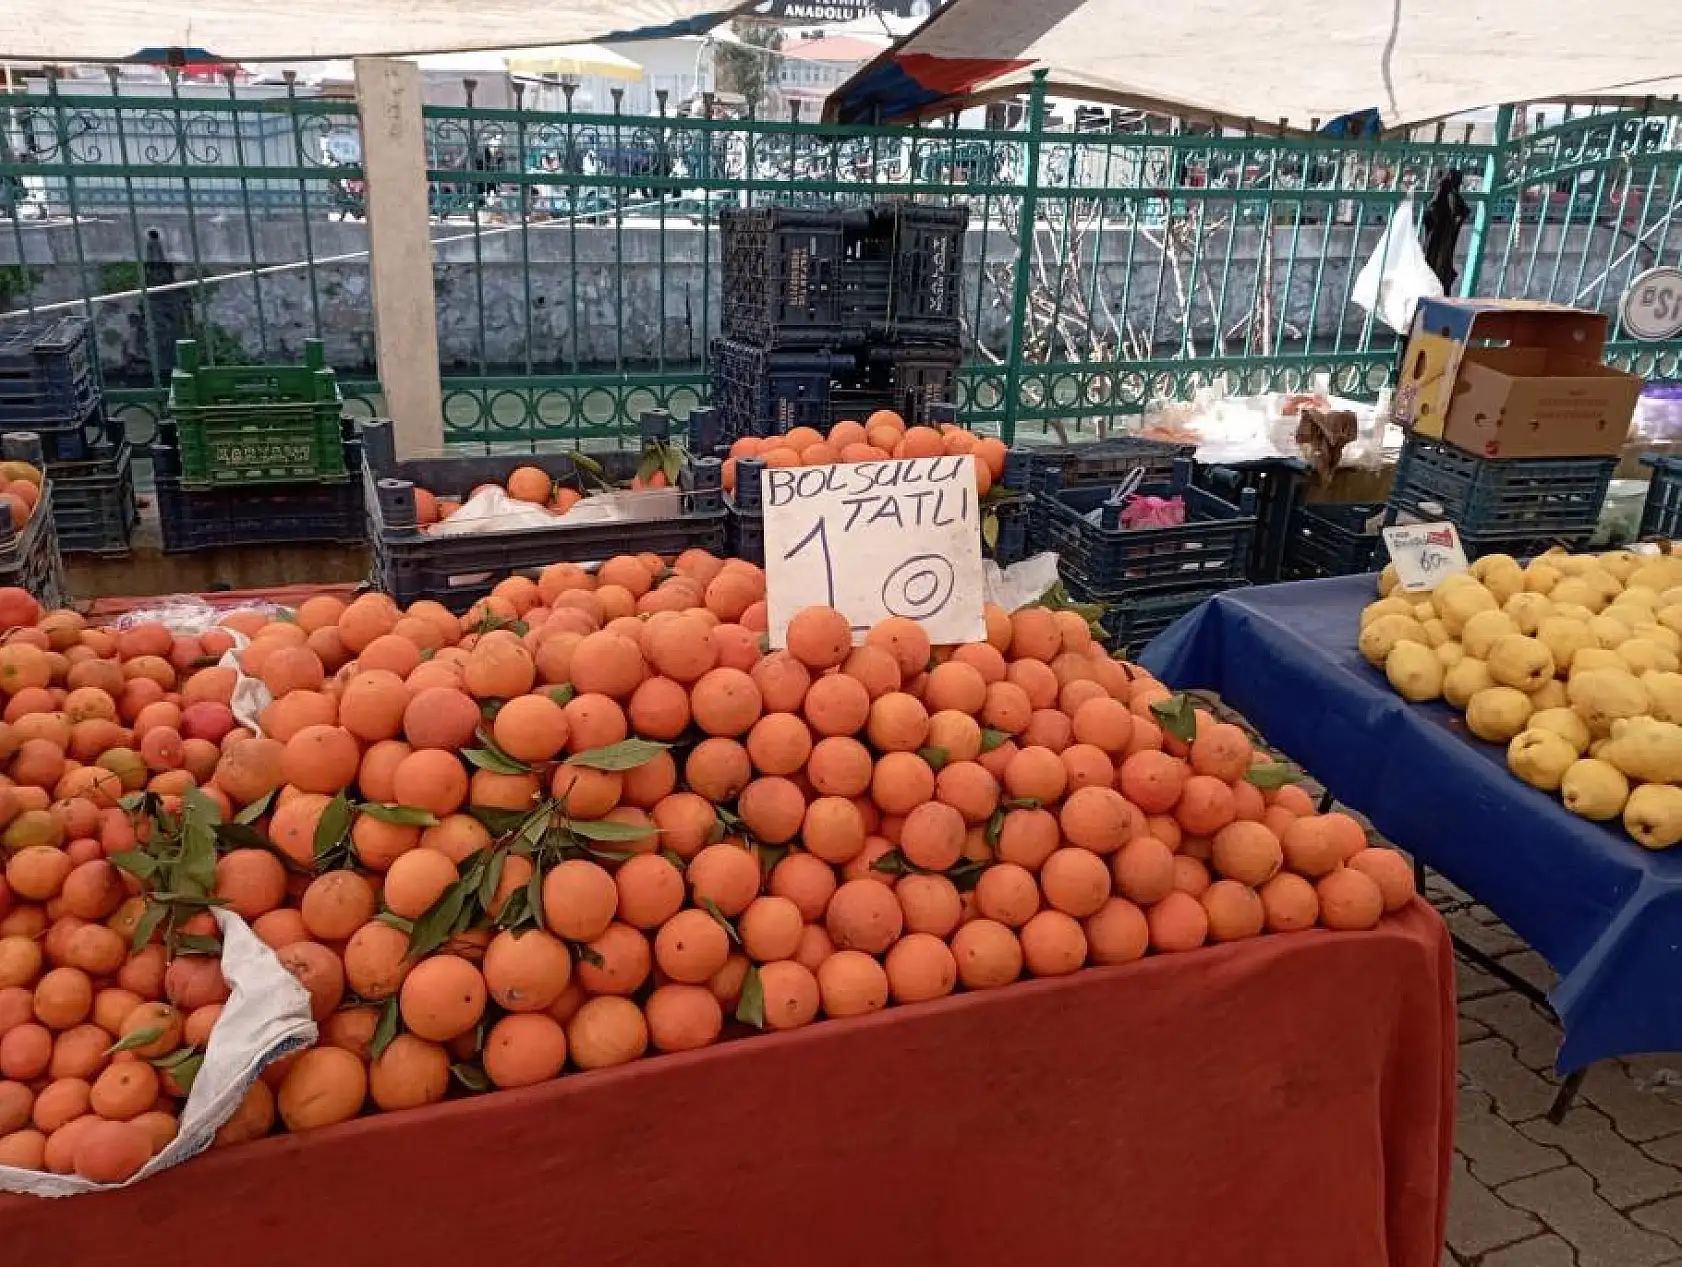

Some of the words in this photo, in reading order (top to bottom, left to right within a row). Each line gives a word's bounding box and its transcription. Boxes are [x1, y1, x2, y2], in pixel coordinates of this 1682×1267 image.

[785, 4, 853, 19] ANADOLU
[769, 457, 964, 506] BOLSULU
[841, 488, 968, 532] TATLI
